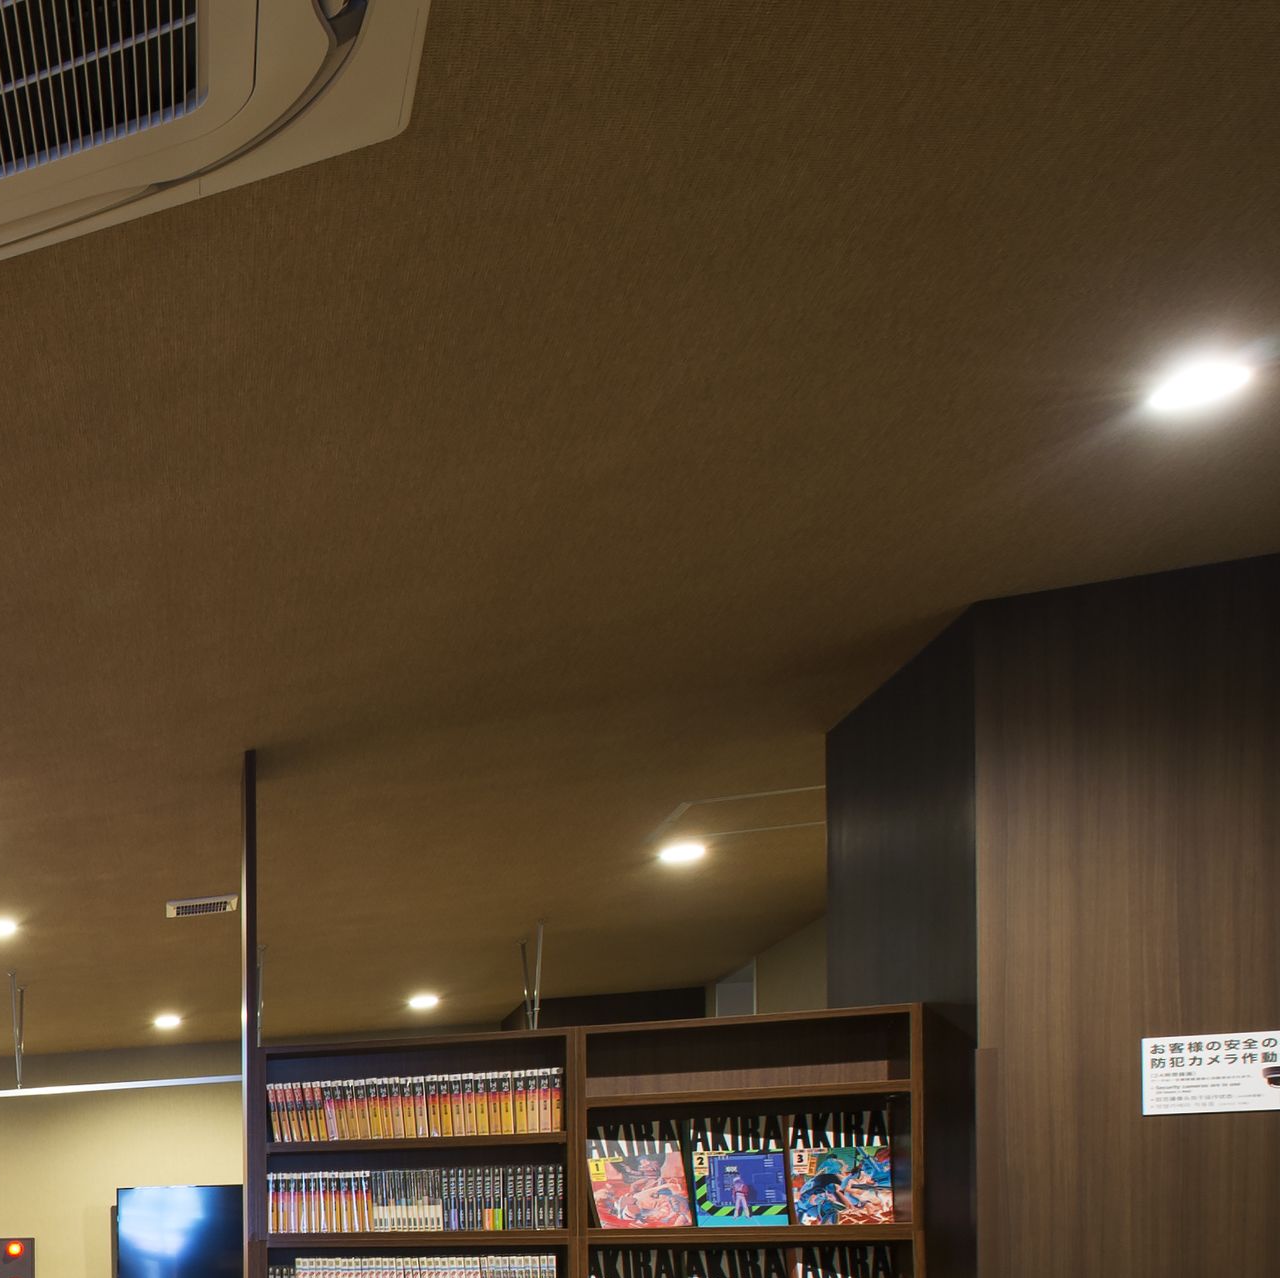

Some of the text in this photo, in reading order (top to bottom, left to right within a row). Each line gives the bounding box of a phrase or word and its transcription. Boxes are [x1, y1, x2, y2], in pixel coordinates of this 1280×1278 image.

[1150, 1052, 1277, 1069] 防犯カメラ作動
[691, 1115, 785, 1152] AKIRA
[790, 1111, 889, 1151] AKIRA
[696, 1156, 705, 1166] 2
[796, 1153, 804, 1163] 3
[594, 1163, 600, 1172] 1
